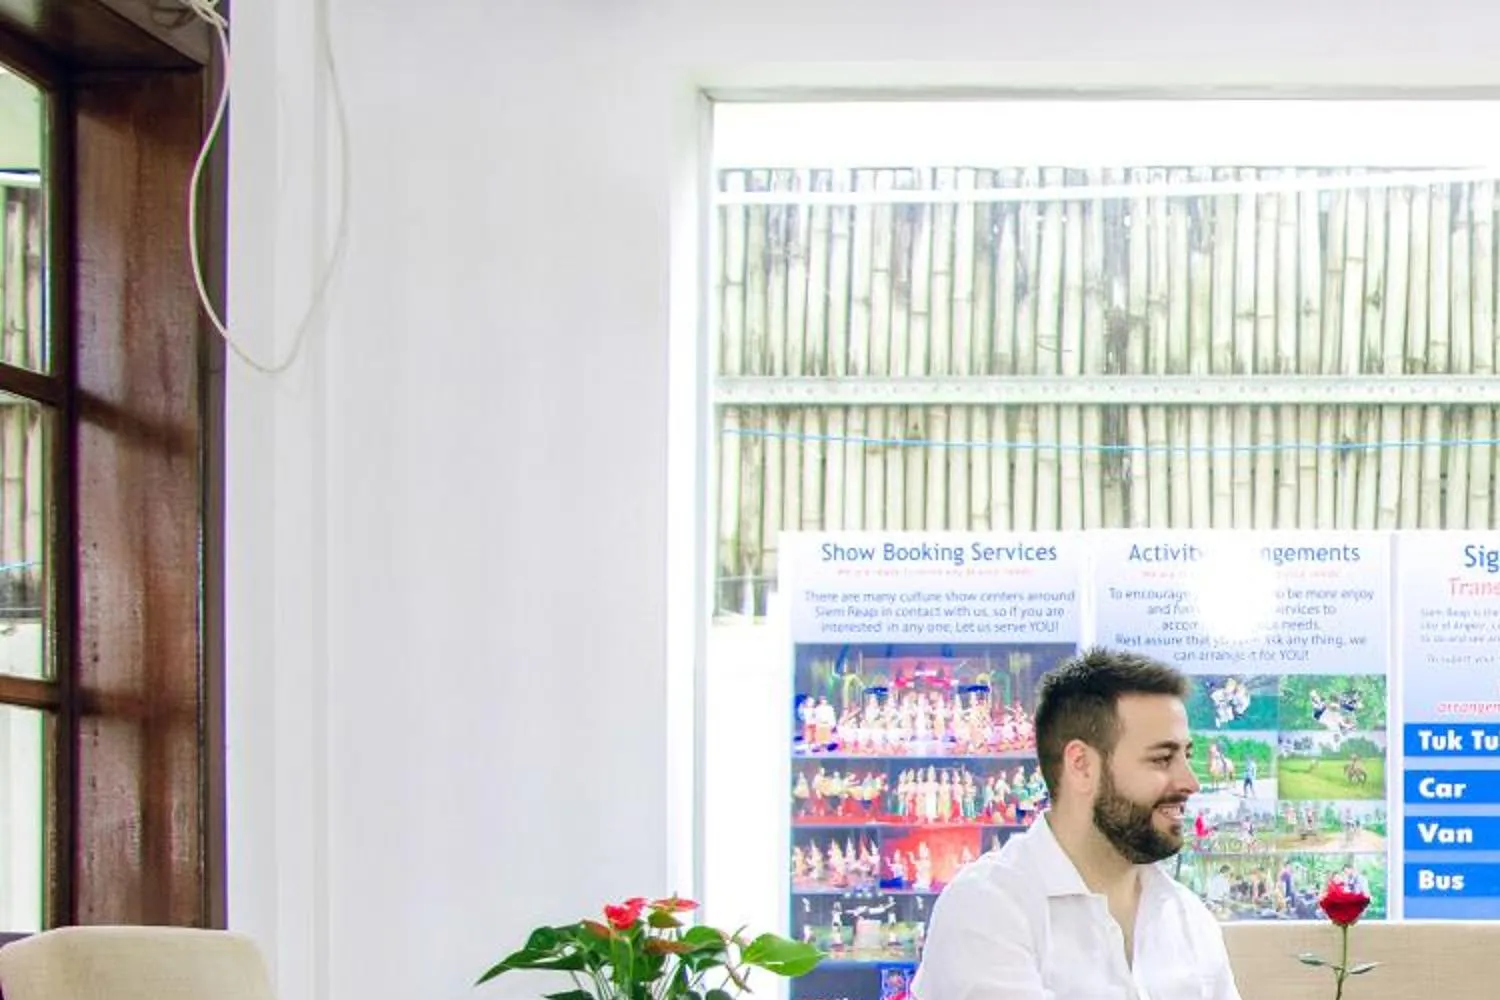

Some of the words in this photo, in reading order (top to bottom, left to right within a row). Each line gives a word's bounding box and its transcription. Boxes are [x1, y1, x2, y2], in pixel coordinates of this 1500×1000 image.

[821, 543, 875, 561] Show
[883, 543, 965, 566] Booking
[971, 543, 1057, 561] Services
[1260, 544, 1361, 567] ngements
[805, 590, 839, 602] There
[841, 590, 860, 602] are
[863, 593, 896, 605] many
[945, 590, 978, 602] show
[1108, 588, 1123, 600] To
[1287, 588, 1302, 600] be
[1306, 590, 1338, 600] more
[1340, 589, 1375, 602] enjoy
[815, 605, 845, 617] Siem
[847, 606, 879, 620] Reap
[881, 605, 893, 617] in
[895, 605, 940, 617] contact
[943, 605, 971, 617] with
[993, 607, 1007, 617] so
[1008, 605, 1018, 617] if
[1020, 607, 1043, 620] you
[1045, 607, 1065, 617] are
[1148, 604, 1171, 615] and
[1323, 605, 1337, 615] to
[821, 621, 882, 633] interested
[887, 621, 899, 633] in
[902, 623, 924, 636] any
[955, 621, 976, 633] Let
[977, 623, 991, 633] us
[993, 623, 1027, 633] serve
[1030, 621, 1059, 633] YOU!
[1285, 636, 1309, 648] any
[1350, 637, 1367, 646] we
[1174, 651, 1194, 661] can
[1258, 649, 1276, 661] for
[1418, 731, 1463, 750] Tuk
[1418, 778, 1467, 798] Car
[1417, 823, 1473, 843] Van
[1418, 870, 1465, 890] Bus
